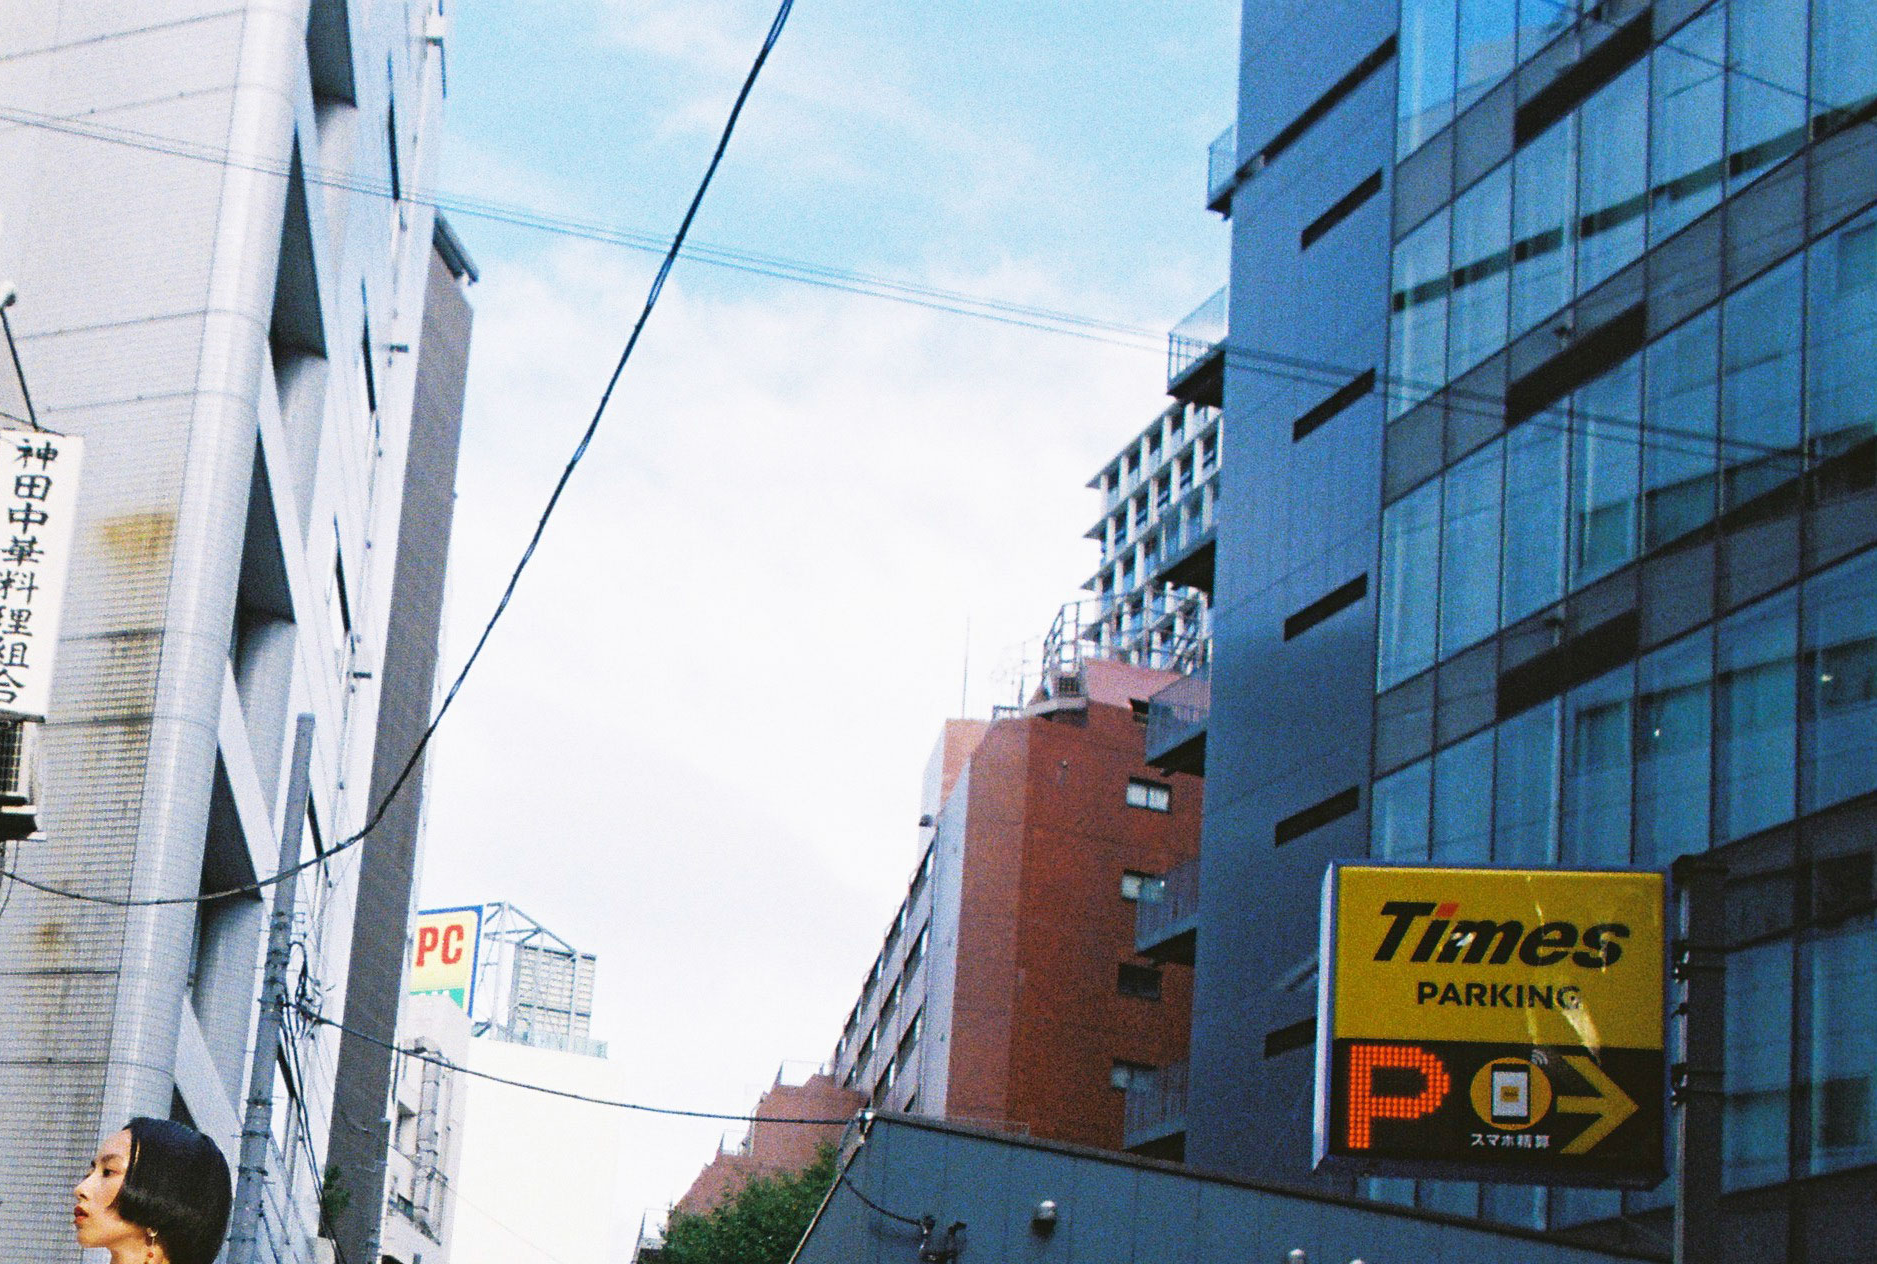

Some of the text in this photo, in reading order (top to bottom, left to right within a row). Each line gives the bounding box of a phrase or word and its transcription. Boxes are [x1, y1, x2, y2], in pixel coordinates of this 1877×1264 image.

[1373, 901, 1630, 969] Times
[1416, 981, 1582, 1010] PARKING
[1348, 1044, 1450, 1150] P
[1470, 1132, 1550, 1149] スマホ精算
